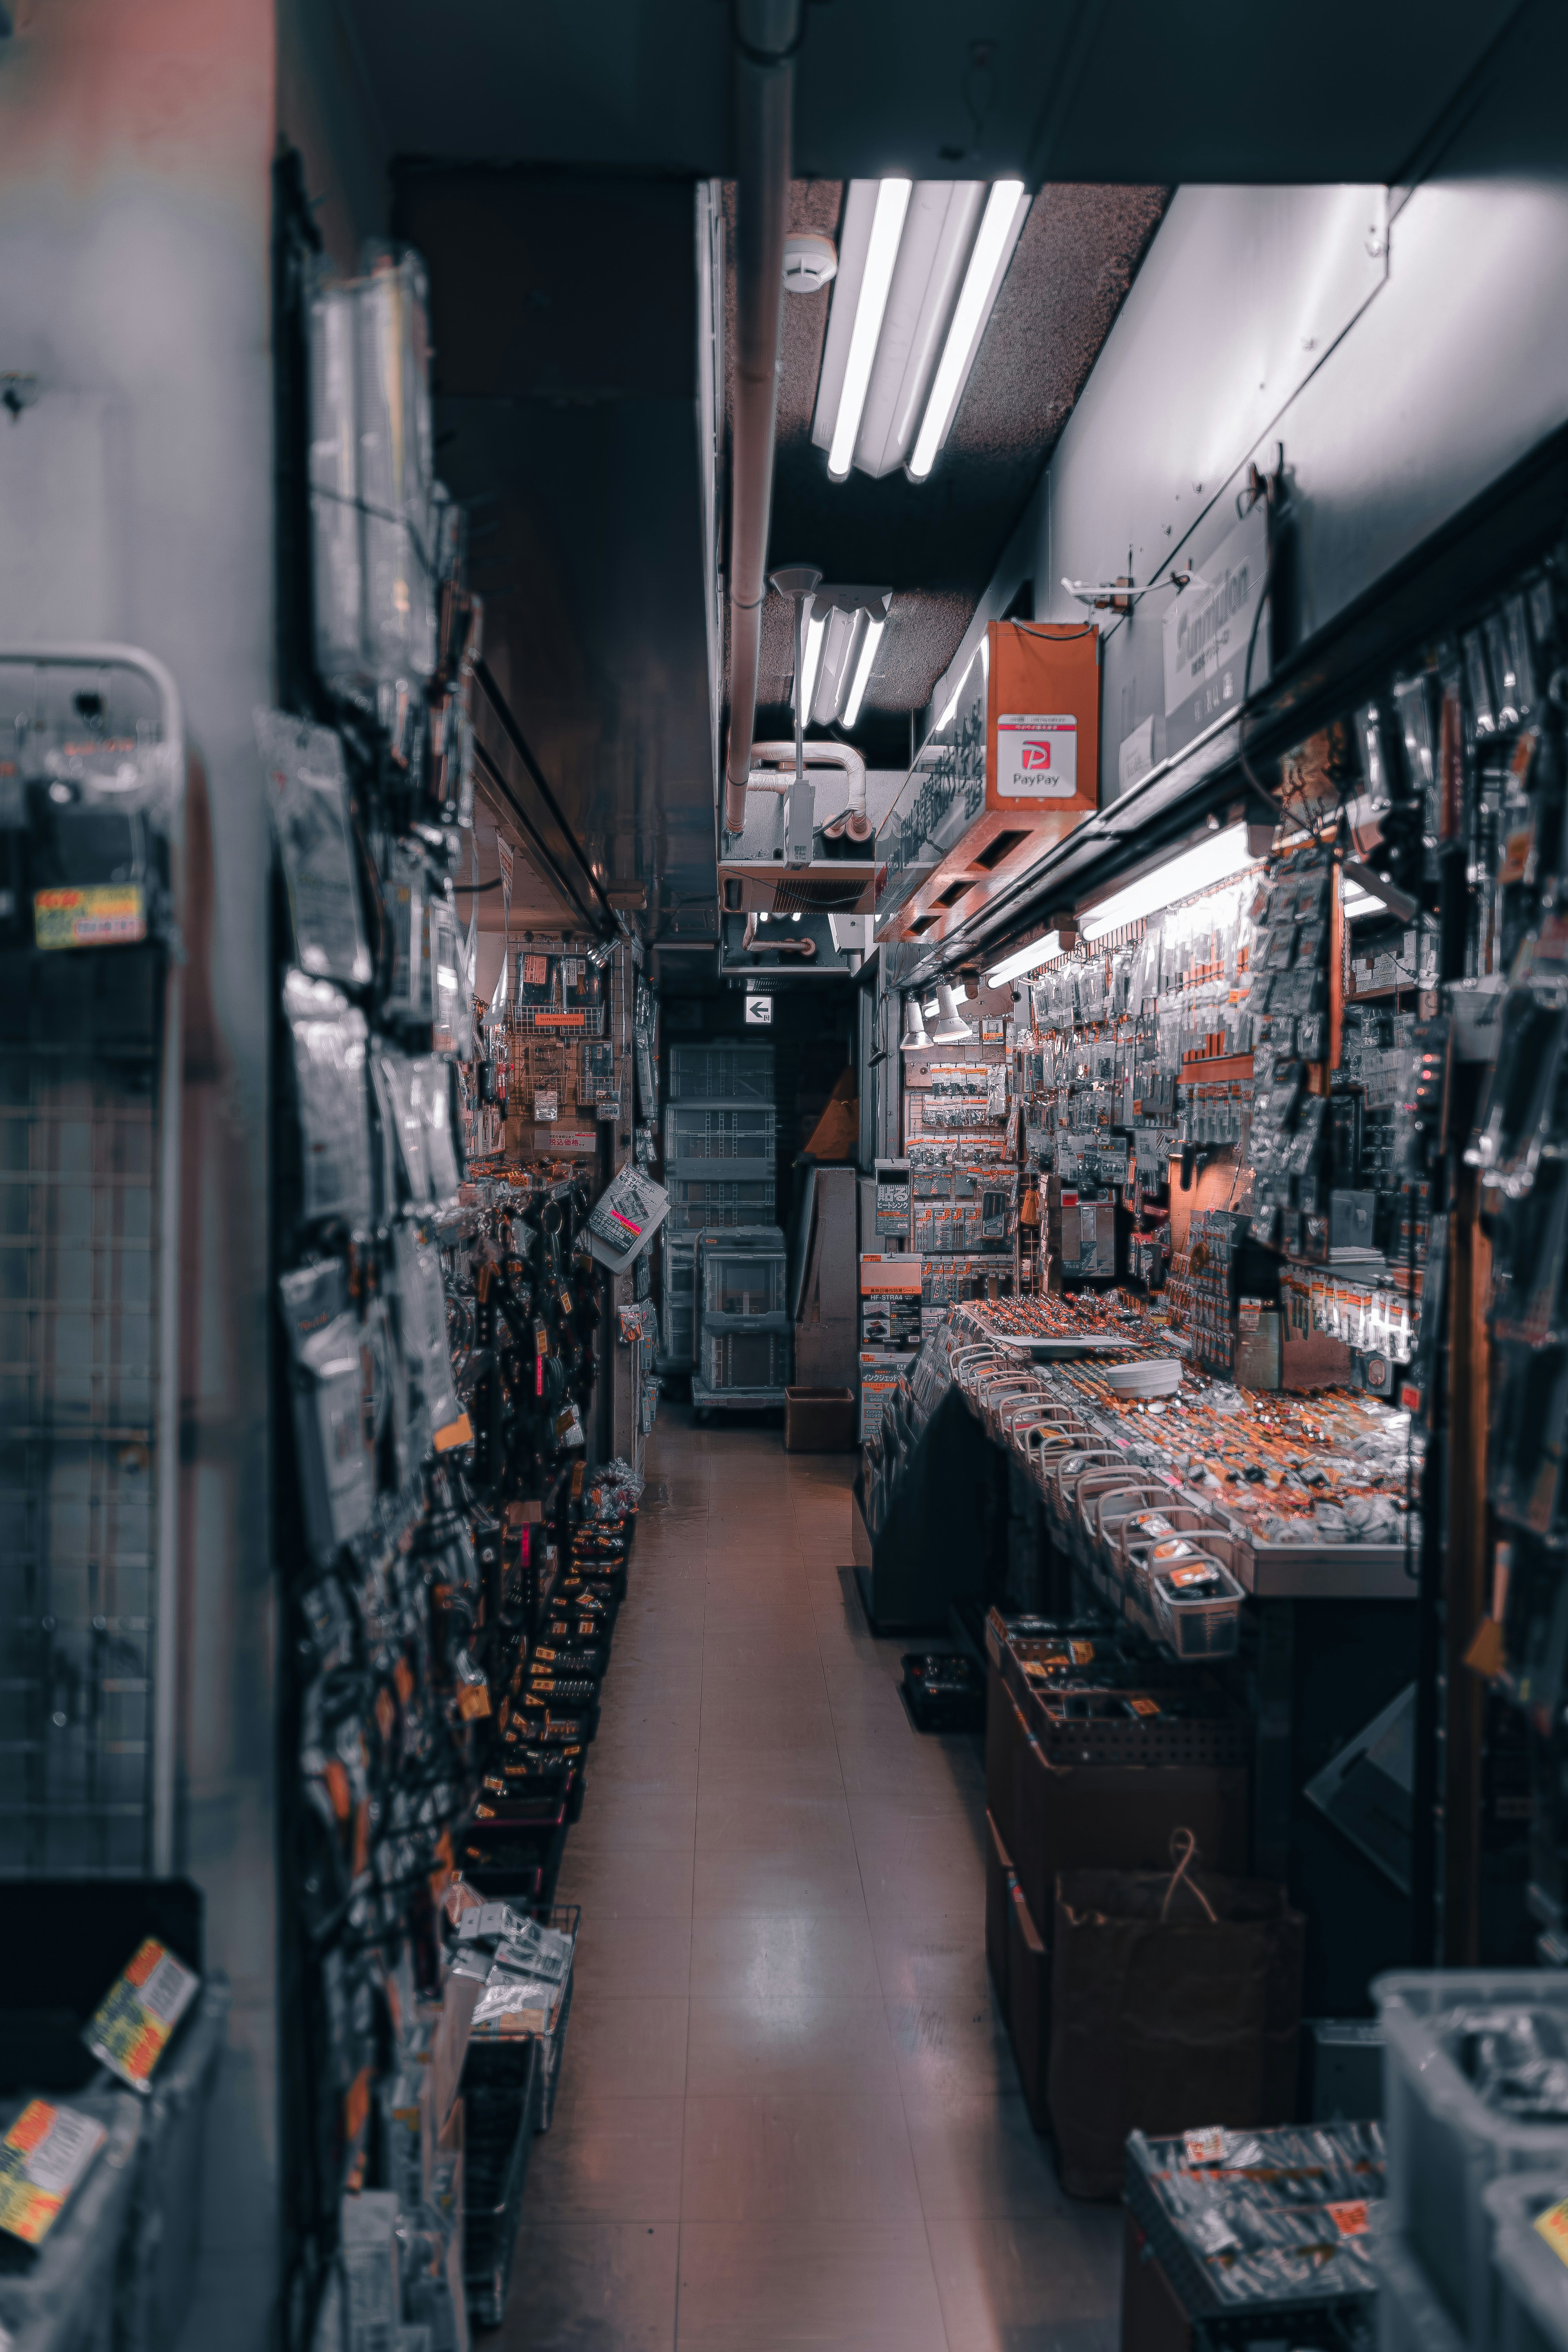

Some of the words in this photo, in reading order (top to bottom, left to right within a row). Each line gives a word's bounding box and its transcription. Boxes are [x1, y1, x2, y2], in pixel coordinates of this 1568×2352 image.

[1013, 774, 1060, 786] PayPay
[549, 1138, 586, 1147] 税込価格です。
[618, 1174, 639, 1191] 電子工作
[622, 1169, 655, 1194] ブレッドボード
[877, 1187, 908, 1202] 貼る
[592, 1216, 624, 1240] ラクラク回路実験
[595, 1211, 633, 1240] ハンダコテを使わずに
